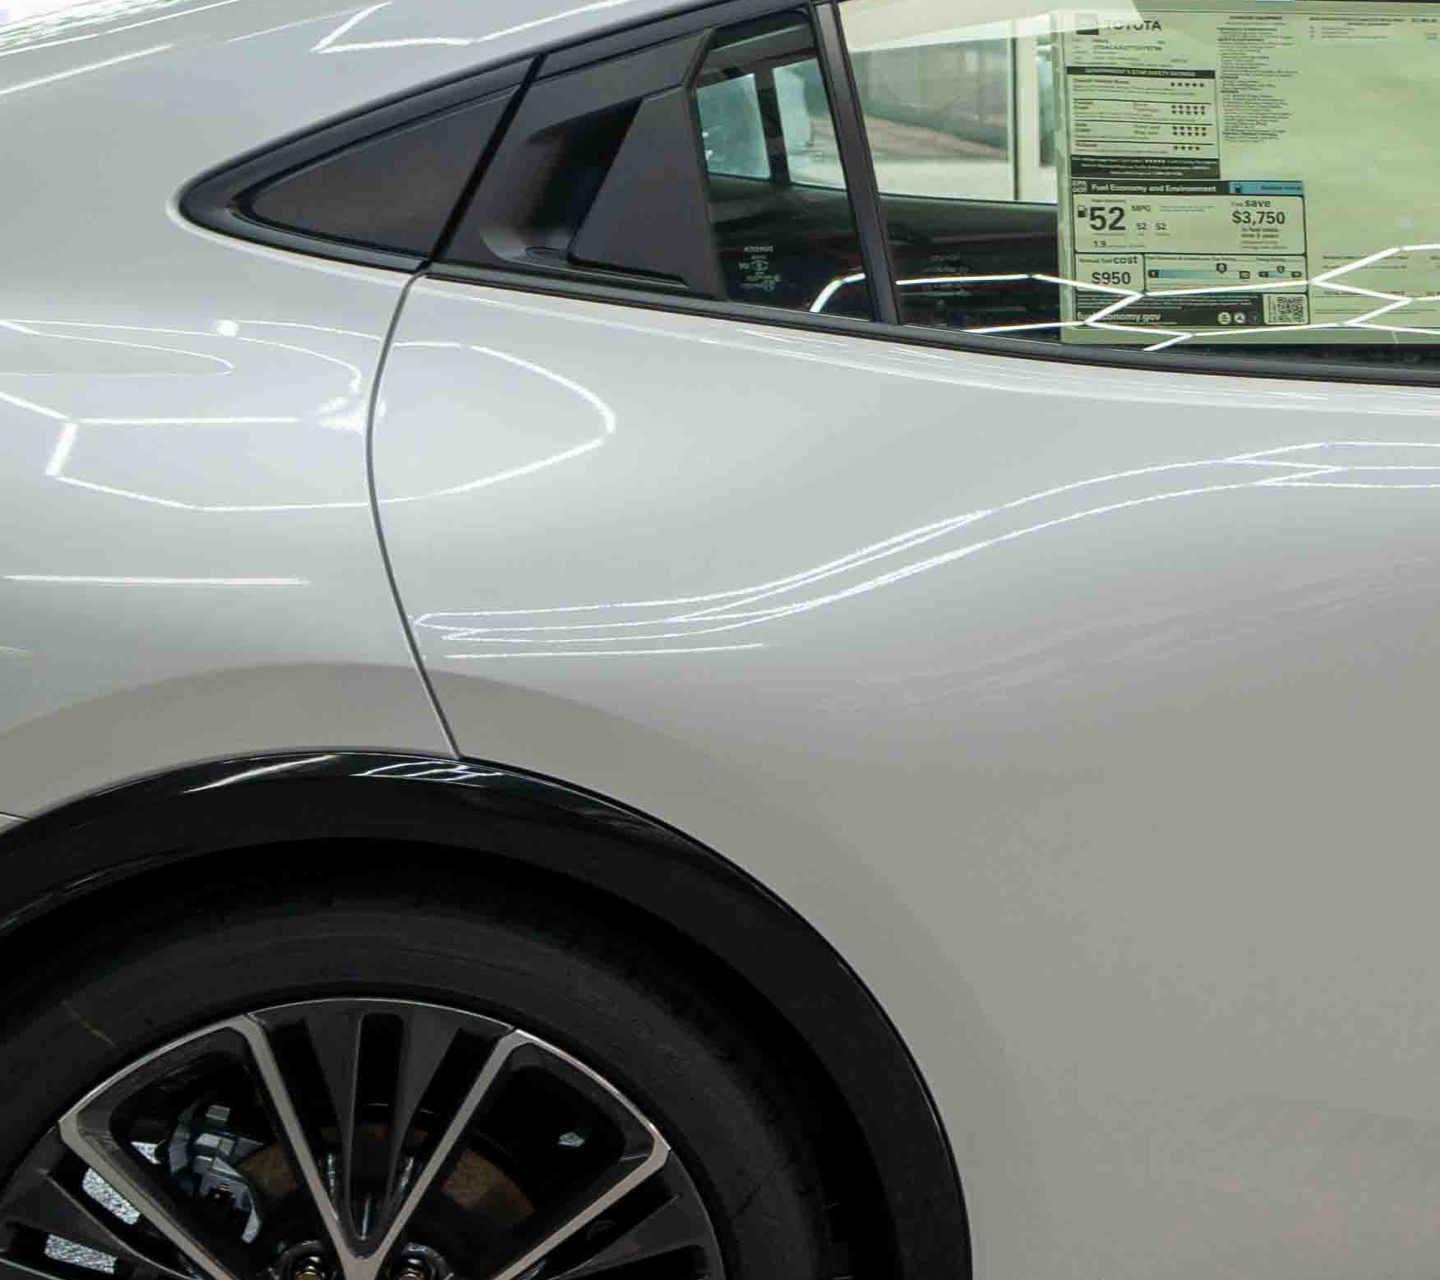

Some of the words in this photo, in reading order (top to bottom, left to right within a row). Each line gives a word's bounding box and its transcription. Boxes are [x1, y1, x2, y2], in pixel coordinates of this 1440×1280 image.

[1244, 200, 1271, 208] save
[1090, 206, 1126, 231] 52
[1231, 210, 1286, 226] $3,750
[1112, 255, 1138, 264] cost
[1091, 271, 1131, 285] $950
